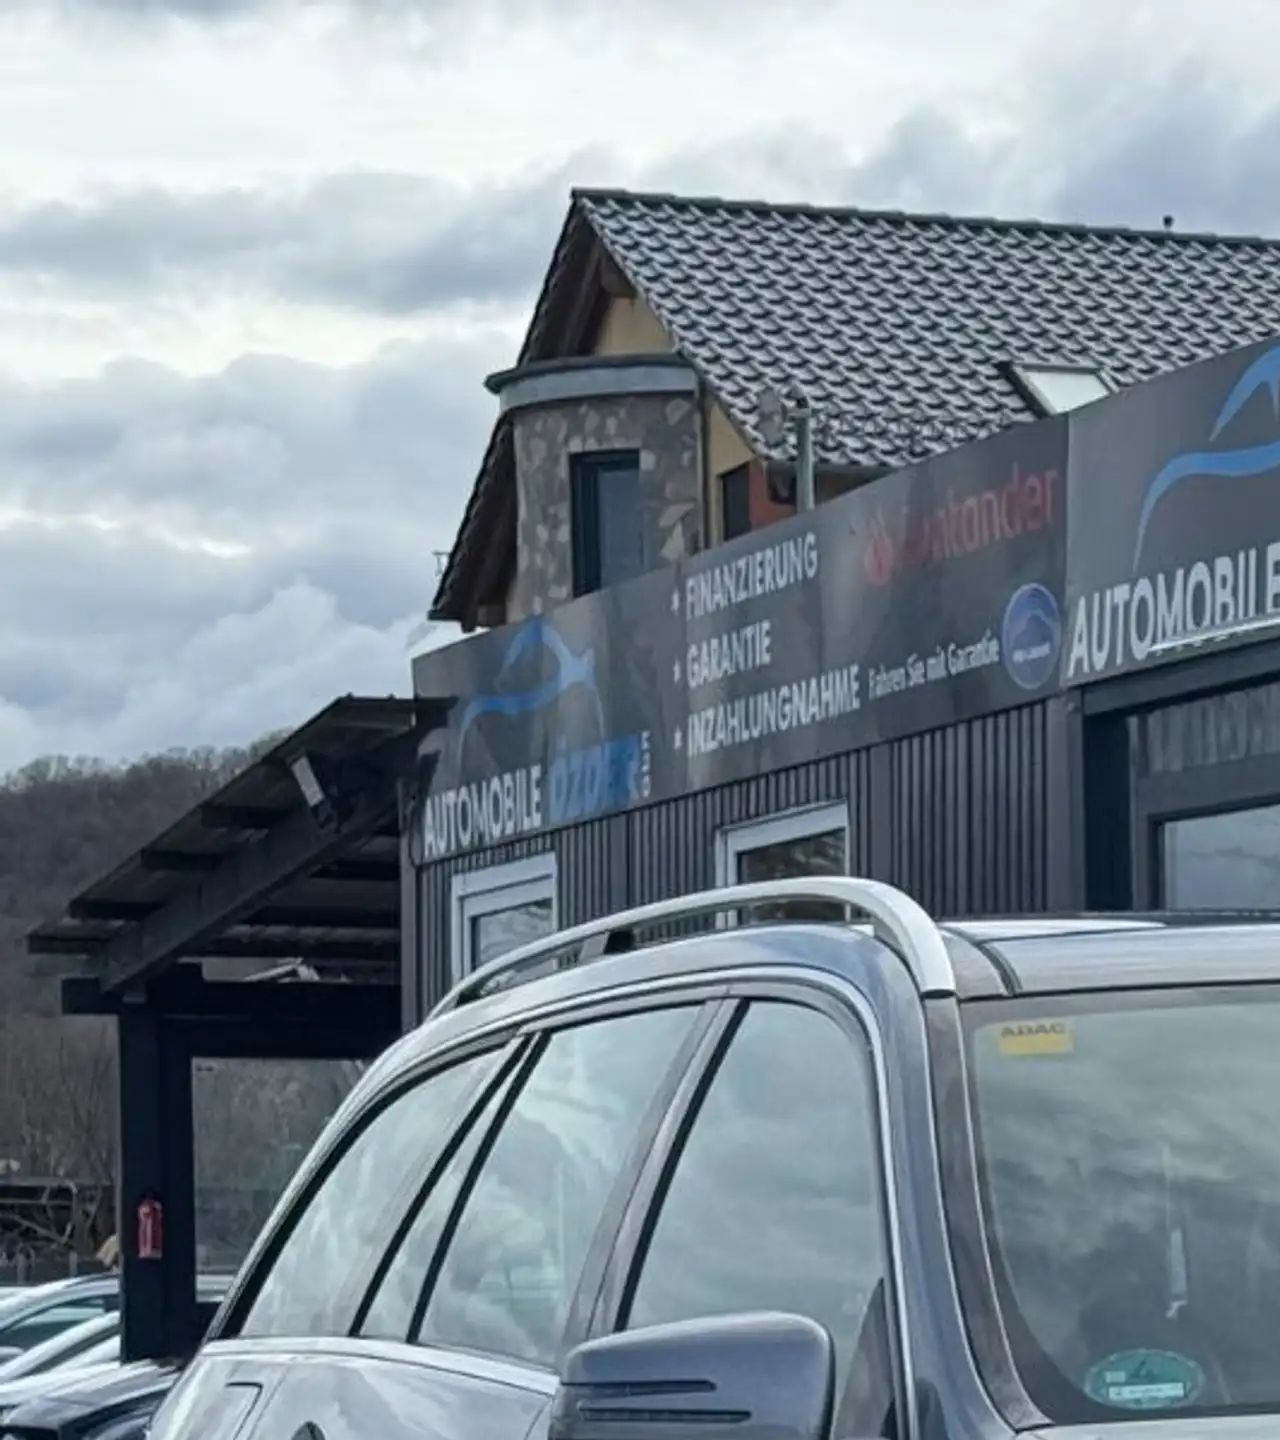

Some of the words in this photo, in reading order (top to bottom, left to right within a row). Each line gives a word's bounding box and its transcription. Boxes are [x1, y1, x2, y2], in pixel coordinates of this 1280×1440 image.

[899, 461, 1058, 572] ntander
[686, 531, 818, 621] FINANZIERUNG
[687, 619, 772, 690] GARANTIE
[688, 663, 862, 758] INZAHLUNGNAHME
[424, 763, 542, 858] AUTOMOBILE
